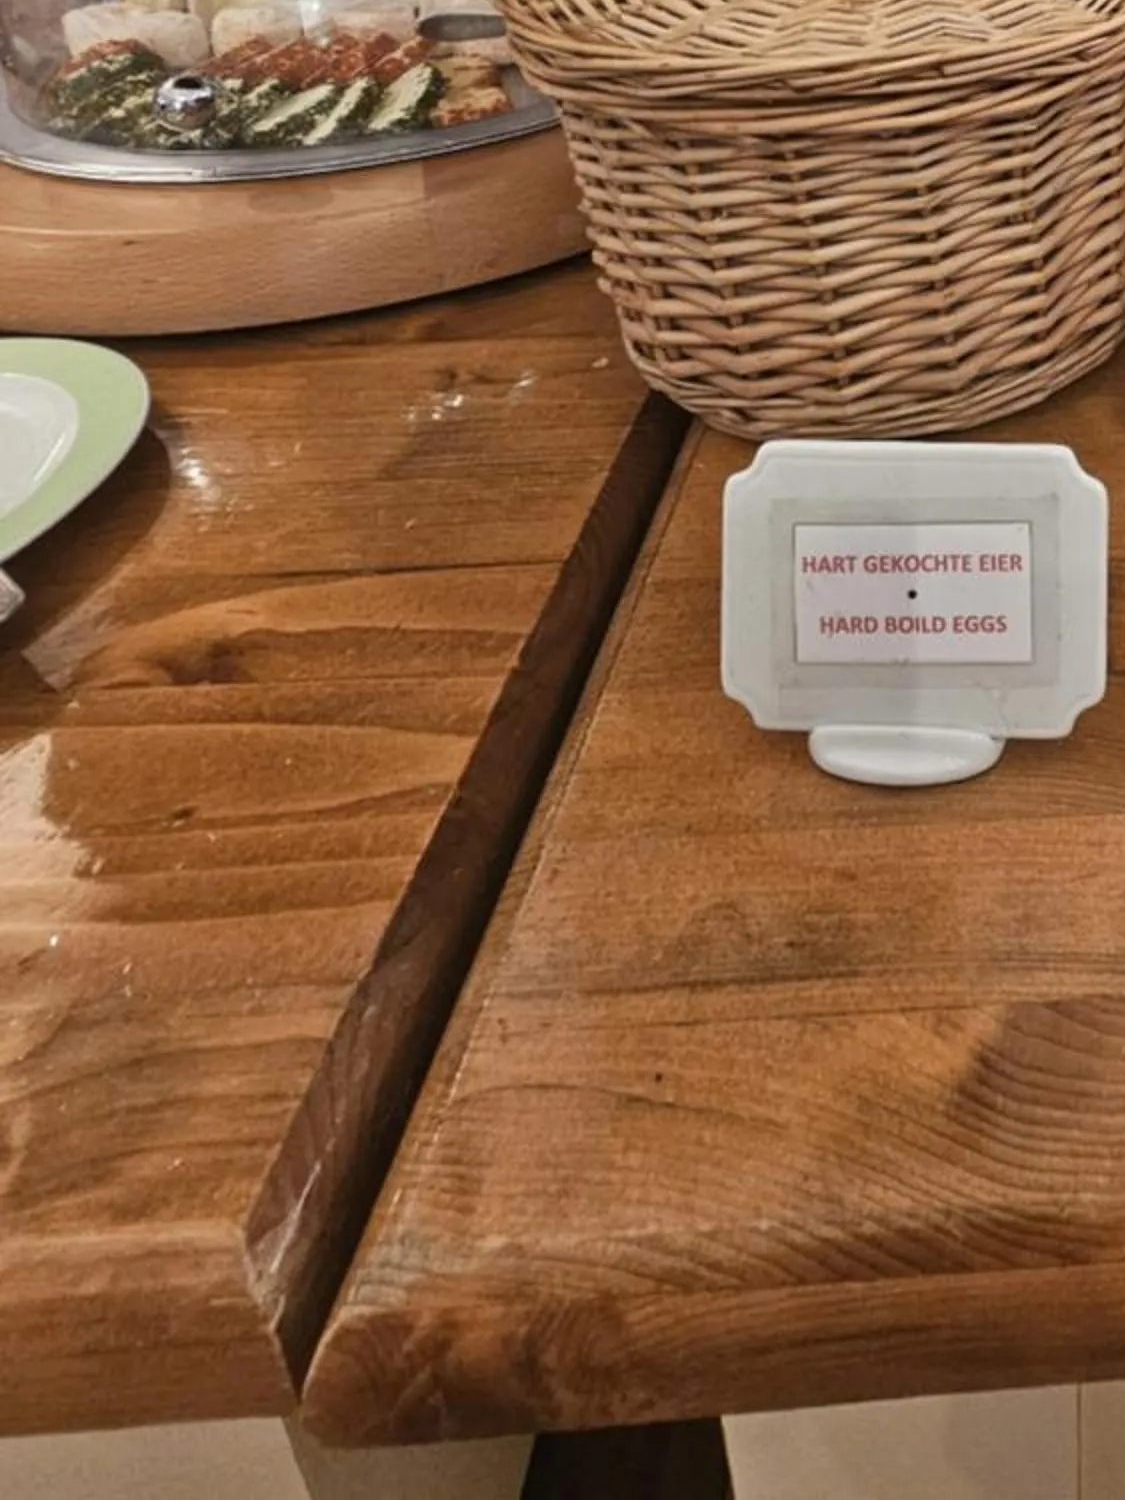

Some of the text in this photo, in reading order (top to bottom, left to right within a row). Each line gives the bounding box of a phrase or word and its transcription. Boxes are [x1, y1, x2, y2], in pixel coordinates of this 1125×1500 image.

[801, 554, 1023, 574] HART GEKOCHTE EIER
[819, 615, 1008, 634] HARD BOILD EGGS
